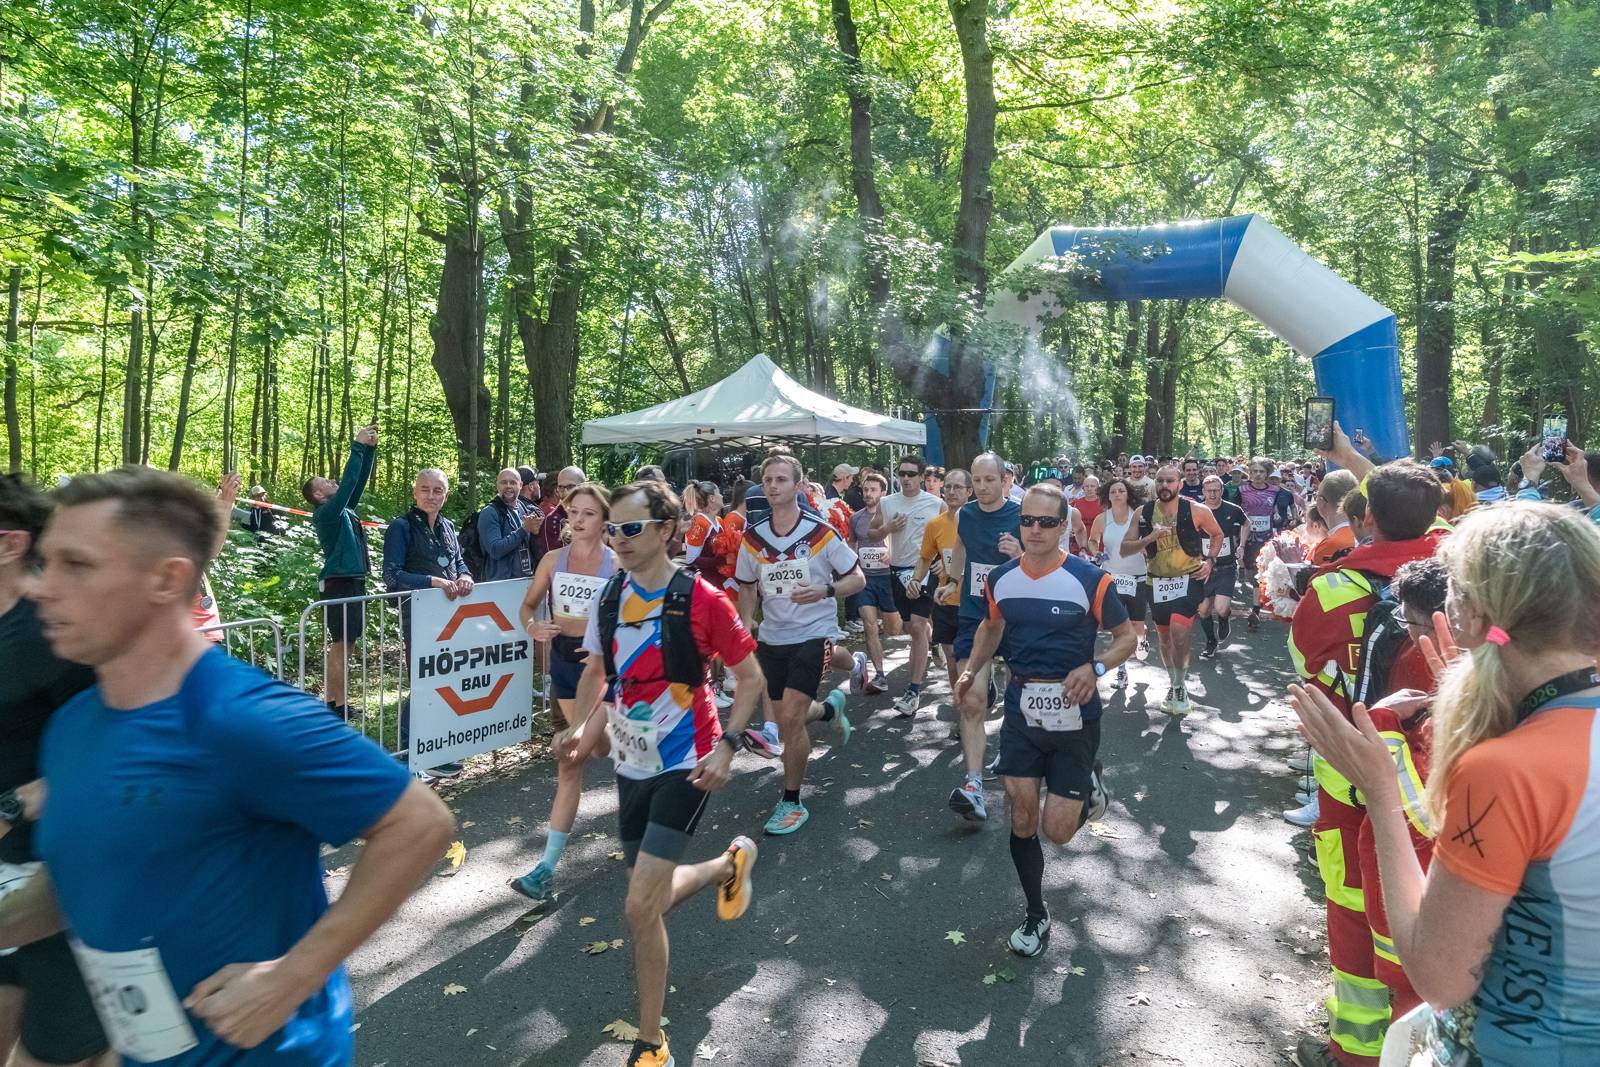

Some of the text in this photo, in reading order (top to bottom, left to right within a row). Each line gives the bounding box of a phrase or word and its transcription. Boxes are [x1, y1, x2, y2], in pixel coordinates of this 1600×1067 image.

[768, 569, 803, 581] 20236
[1159, 581, 1184, 592] 20302
[418, 640, 529, 679] HÖPPNER
[461, 673, 491, 692] BAU
[1027, 696, 1072, 710] 20399
[416, 713, 527, 755] bau-hoeppner.de
